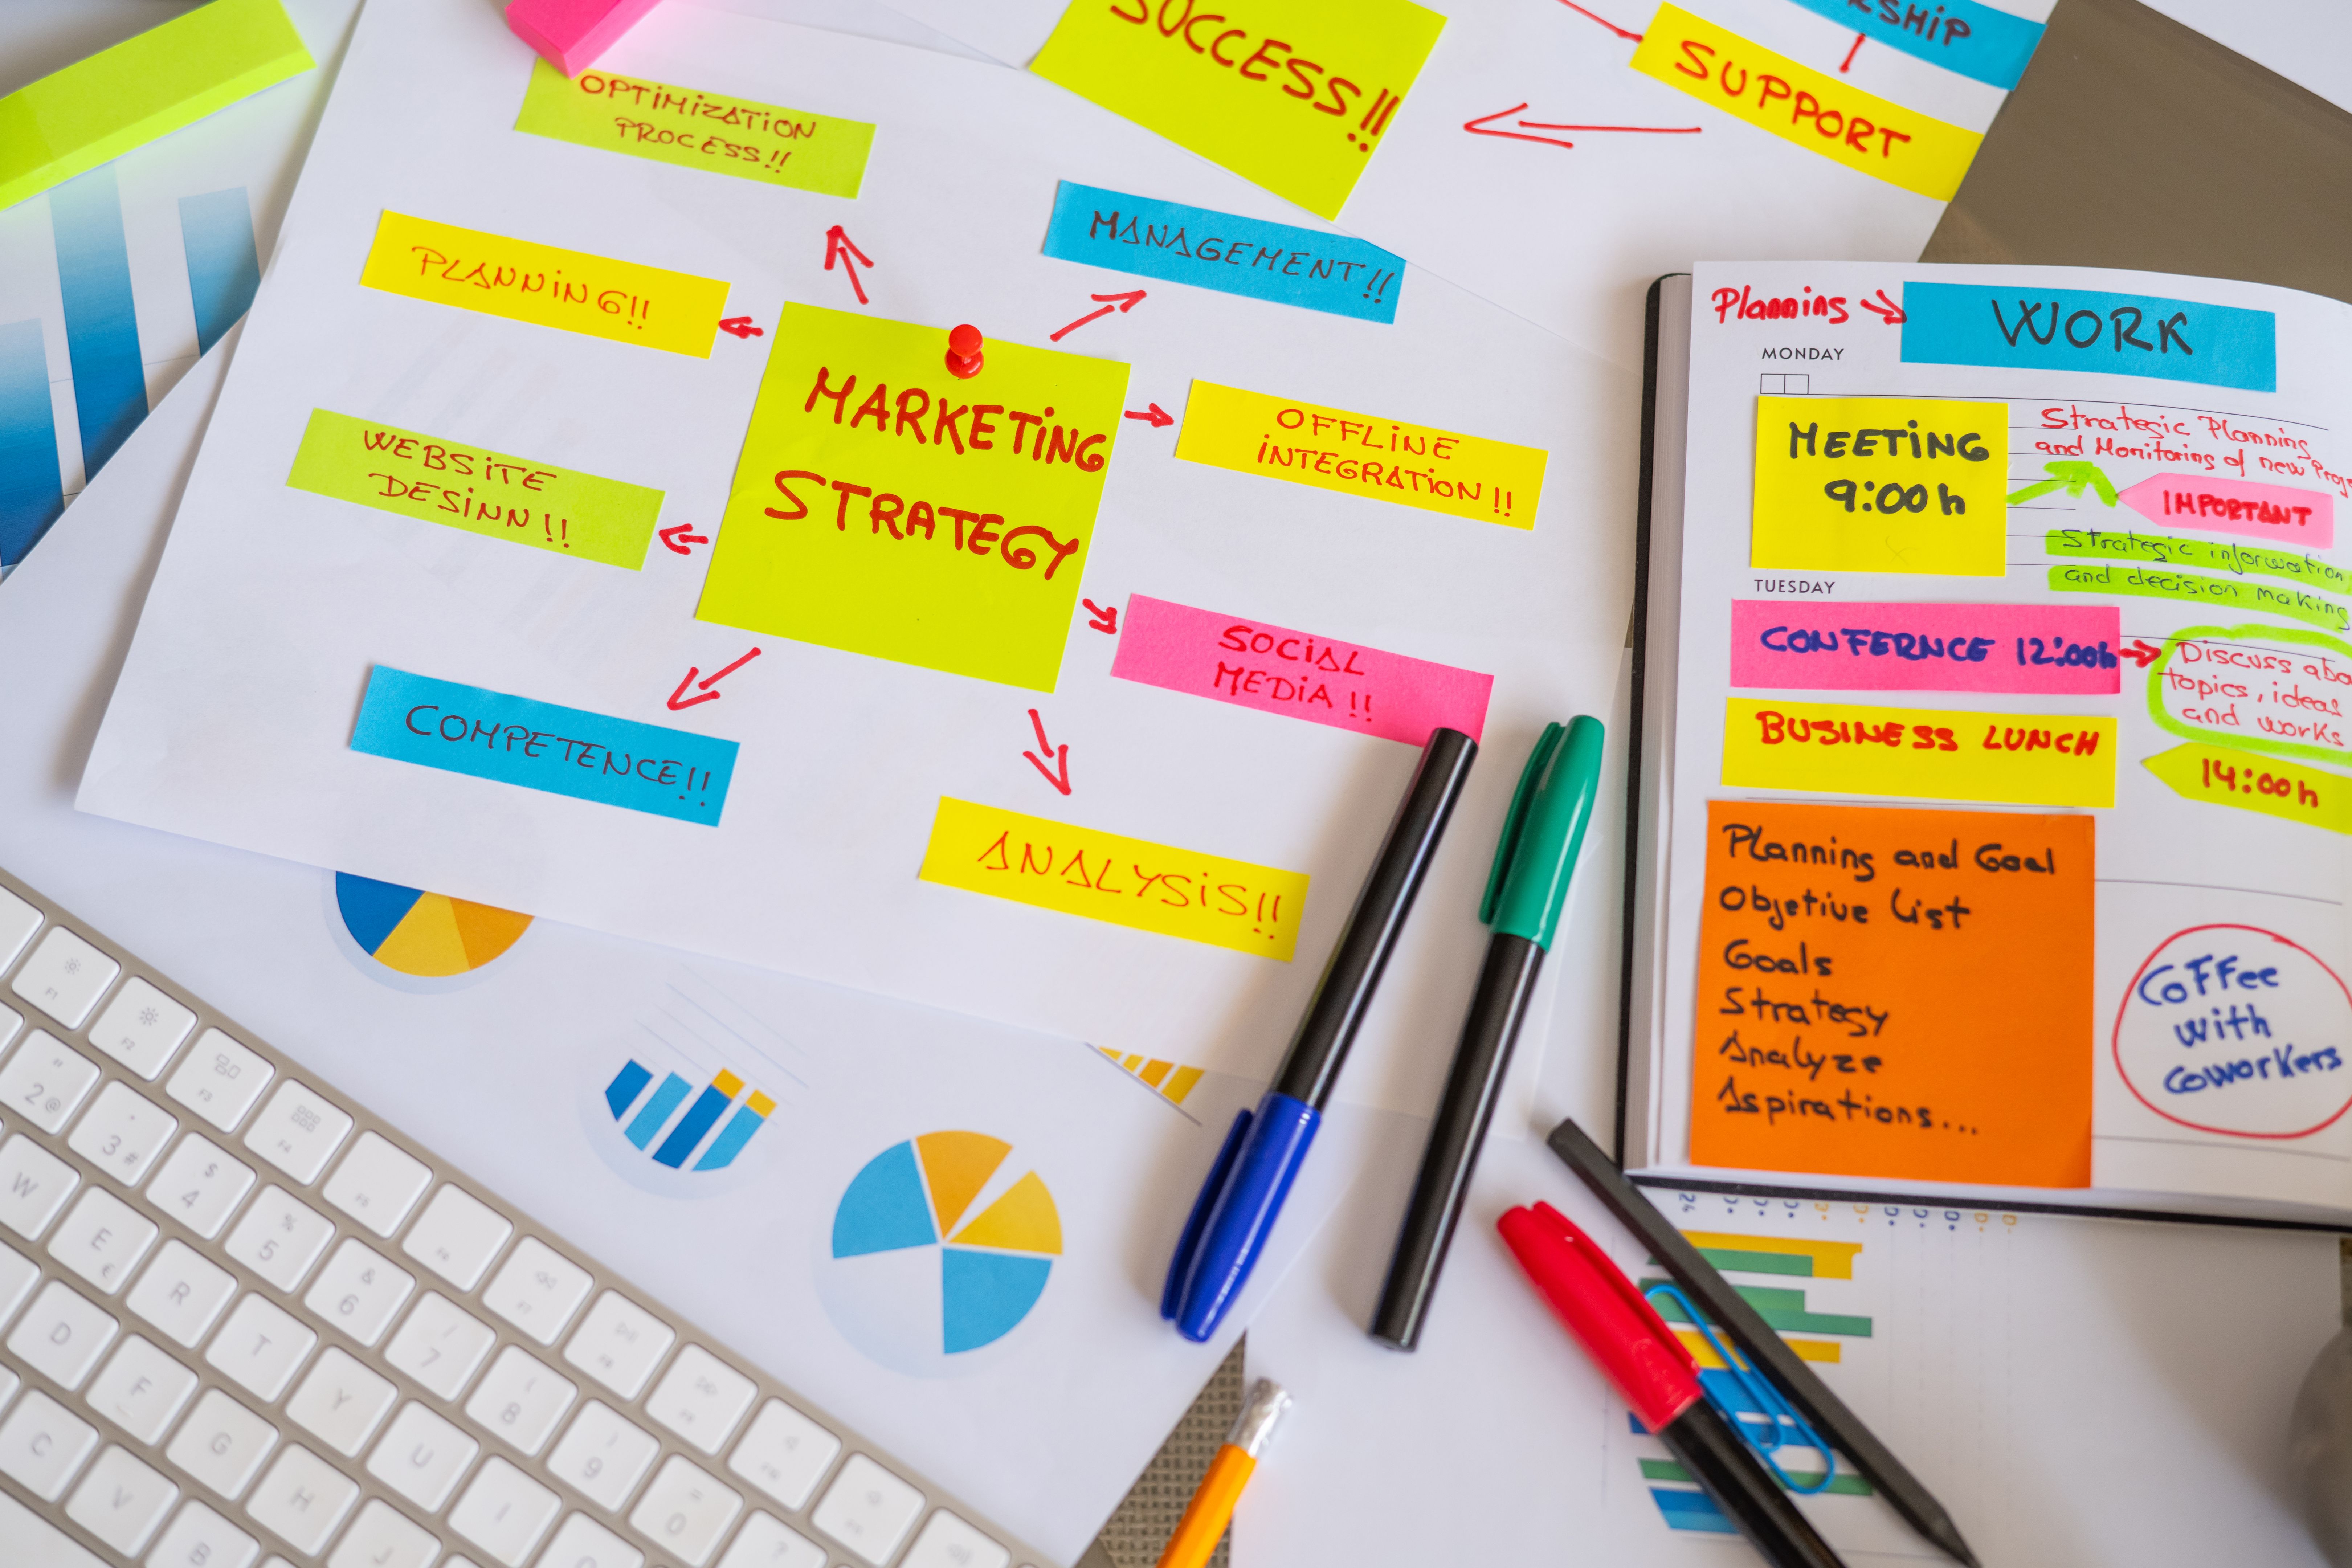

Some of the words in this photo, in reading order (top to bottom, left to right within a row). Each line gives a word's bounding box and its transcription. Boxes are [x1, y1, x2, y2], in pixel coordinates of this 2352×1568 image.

[1675, 40, 1911, 158] SUPPORT
[1992, 299, 2193, 355] WORK
[1762, 348, 1844, 361] MONDAY
[2041, 404, 2190, 439] Strategic
[2197, 415, 2311, 461] Planning
[2035, 434, 2082, 456] and
[2223, 449, 2245, 477] of
[2259, 457, 2304, 476] new
[2163, 490, 2312, 526] IMPORTANT
[764, 470, 1079, 580] STRATEGY
[2061, 528, 2193, 562] Strategic
[2210, 542, 2343, 582] information
[1755, 579, 1836, 594] TUESDAY
[2065, 564, 2110, 585] and
[2128, 565, 2237, 597] decision
[2257, 587, 2351, 630] making
[1760, 626, 1996, 662] CONFERNCE
[2175, 640, 2291, 673] Discuss
[2303, 657, 2352, 685] abo
[2272, 681, 2343, 717] ideas
[2182, 705, 2239, 726] and
[1755, 711, 1958, 752] BUSINESS
[1982, 725, 2099, 756] LUNCH
[1722, 824, 1875, 882] Planning
[1893, 839, 1959, 870] and
[1973, 844, 2055, 874] Goal
[1719, 885, 1869, 931] Objetive
[1891, 888, 1971, 930] List
[1723, 940, 1833, 976] Goals
[45, 987, 58, 1001] F1
[1719, 987, 1889, 1037] Strategy
[2173, 1004, 2272, 1048] with
[121, 1037, 135, 1051] F2
[1719, 1031, 1882, 1081] Analyze
[24, 1084, 44, 1105] 2
[45, 1098, 61, 1113] @
[102, 1135, 121, 1155] 3
[204, 1163, 218, 1179] $
[12, 1172, 39, 1199] W
[181, 1190, 200, 1208] 4
[90, 1227, 112, 1251] E
[259, 1240, 279, 1261] 5
[169, 1282, 191, 1306] R
[339, 1294, 359, 1315] 6
[50, 1322, 72, 1345] D
[252, 1335, 272, 1356] T
[421, 1348, 441, 1368] 7
[130, 1377, 152, 1397] F
[332, 1388, 352, 1411] Y
[501, 1402, 521, 1426] 8
[30, 1433, 52, 1457] C
[211, 1433, 232, 1456] G
[411, 1443, 434, 1469] U
[583, 1457, 603, 1479] 9
[112, 1487, 133, 1509] V
[291, 1486, 315, 1512] H
